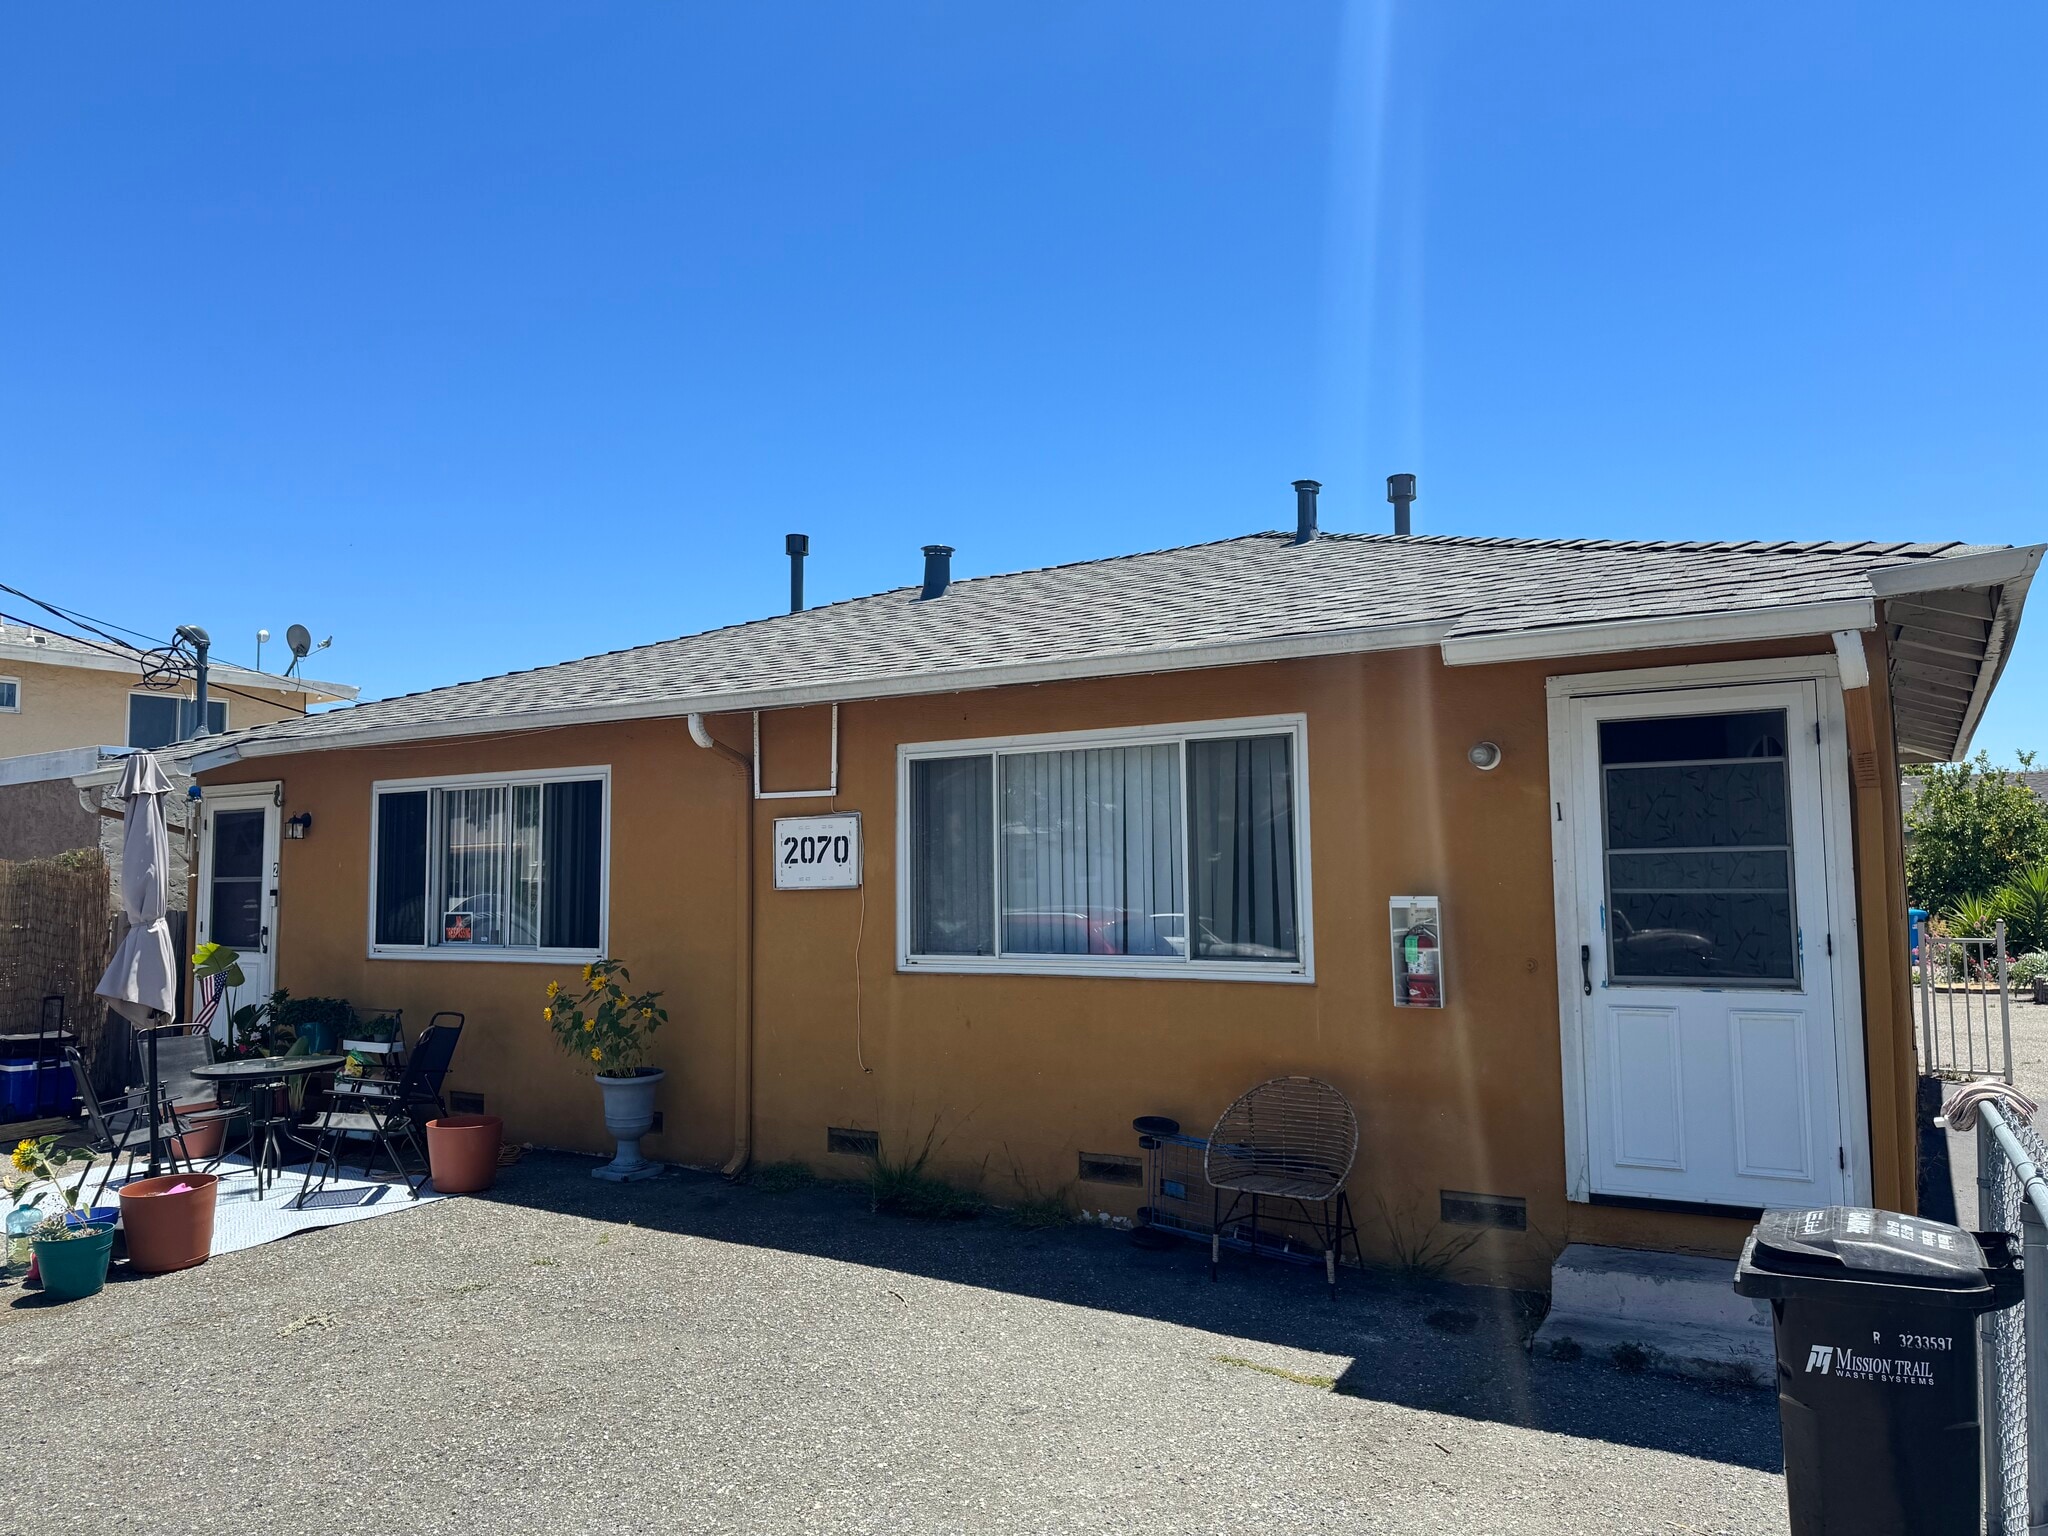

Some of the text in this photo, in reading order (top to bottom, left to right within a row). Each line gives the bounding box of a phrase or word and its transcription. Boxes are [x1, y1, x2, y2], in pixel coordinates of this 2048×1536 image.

[784, 836, 848, 864] 2070
[1873, 1331, 1952, 1351] R 3233597
[1836, 1347, 1933, 1378] MISSION TRAIL
[1836, 1369, 1934, 1386] WASTE SYSTEMS
